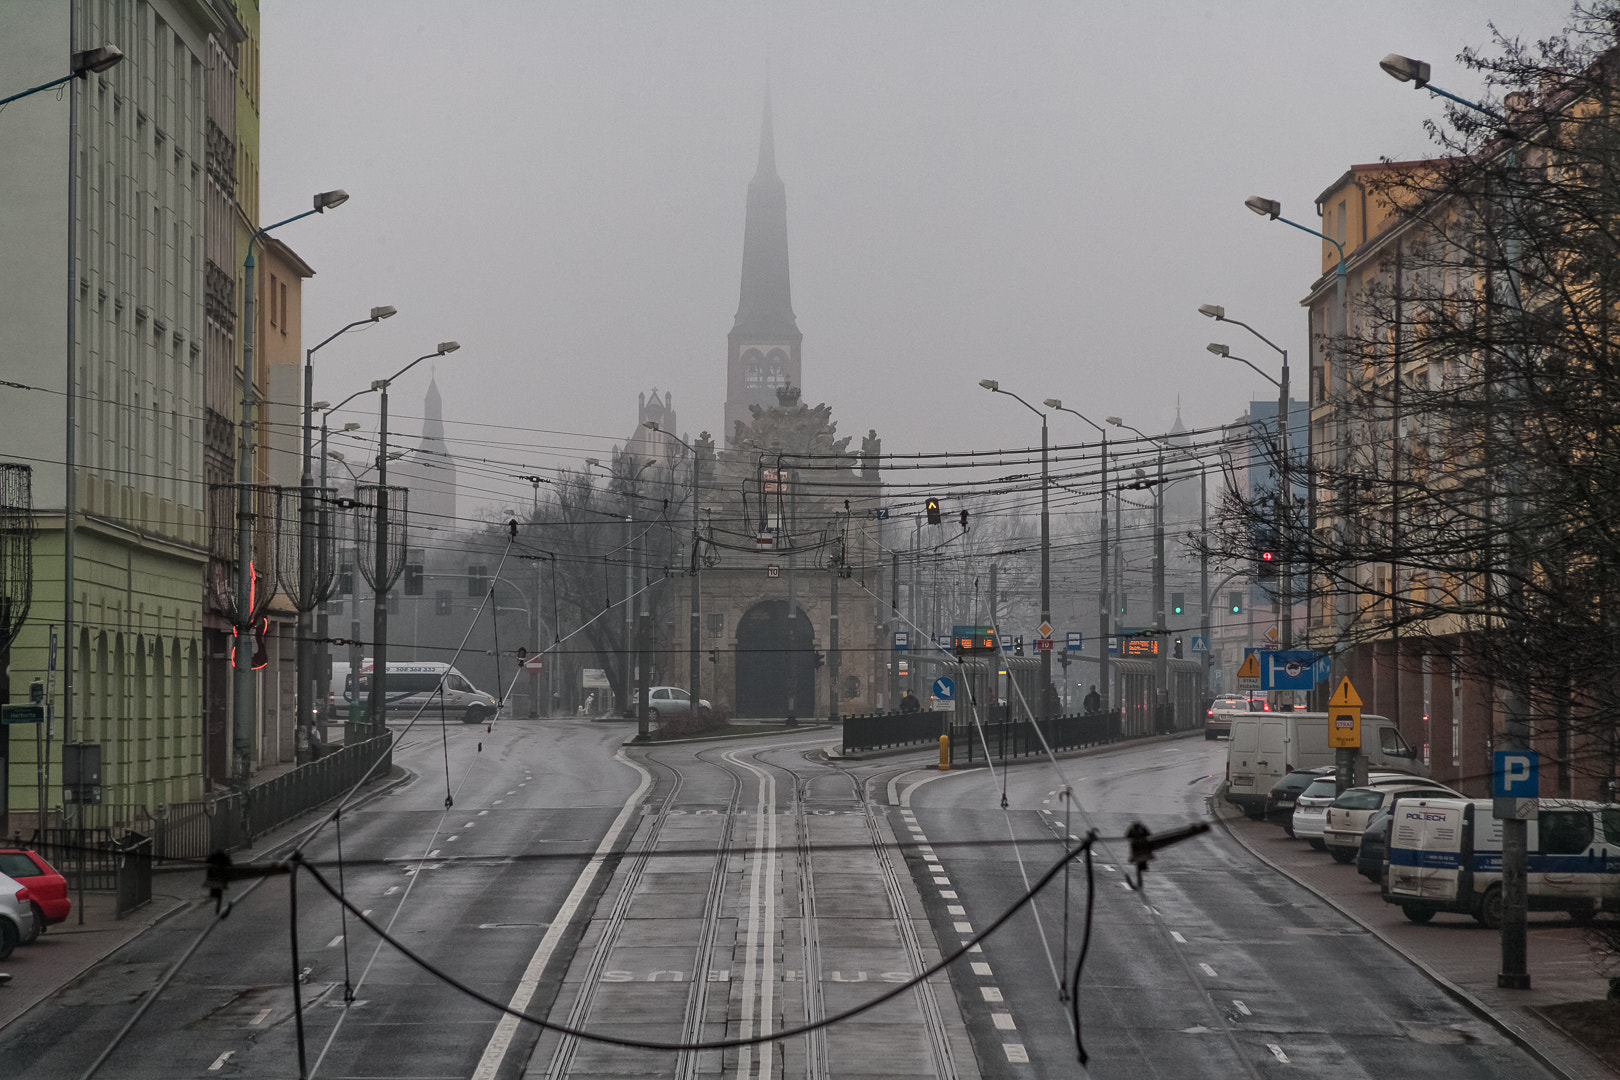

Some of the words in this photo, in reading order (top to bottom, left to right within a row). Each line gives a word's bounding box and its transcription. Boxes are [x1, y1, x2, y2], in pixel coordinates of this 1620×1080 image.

[770, 568, 778, 576] 10
[1041, 640, 1050, 648] 10
[1504, 756, 1530, 791] P
[1406, 812, 1446, 822] POLTECH
[786, 970, 912, 982] BUS
